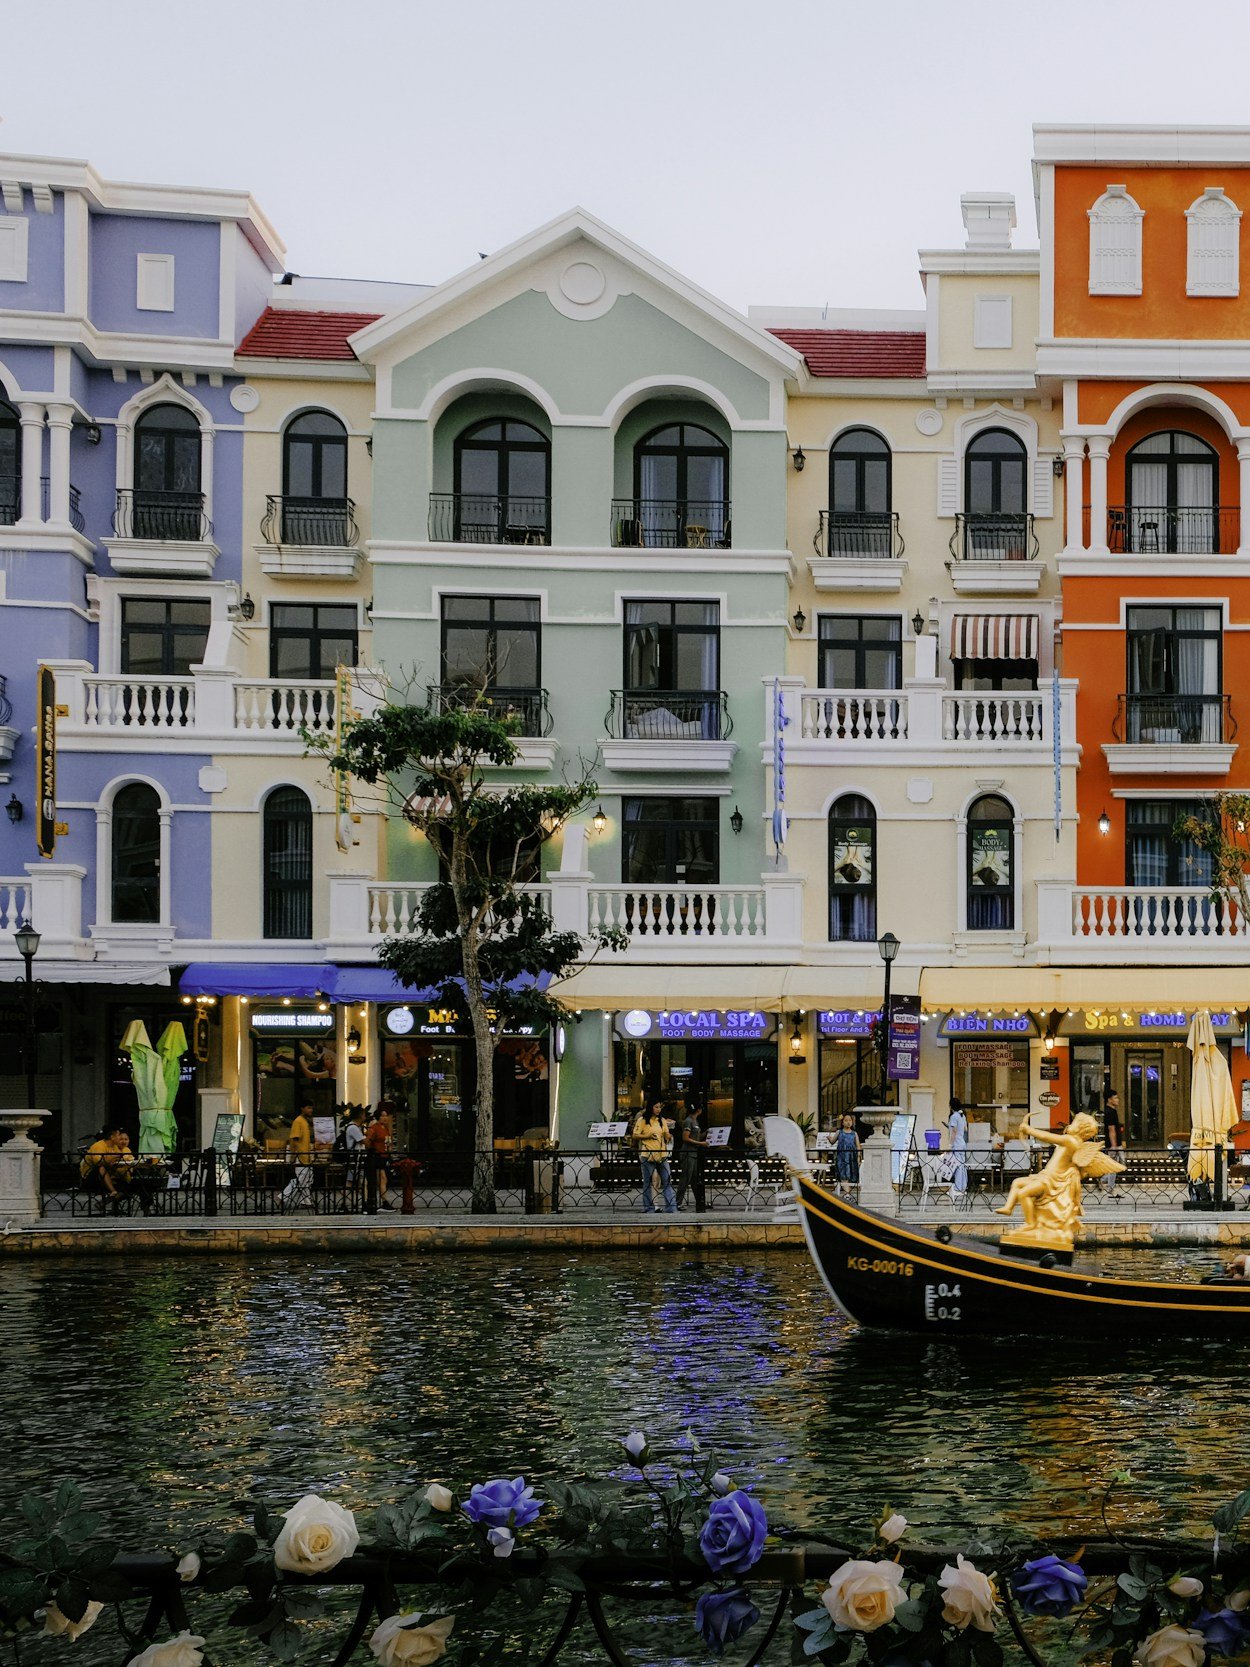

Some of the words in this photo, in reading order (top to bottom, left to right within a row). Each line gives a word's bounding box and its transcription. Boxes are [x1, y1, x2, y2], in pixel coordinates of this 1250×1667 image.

[252, 1015, 296, 1027] NOURISHING
[297, 1015, 333, 1027] SHAMPOO
[659, 1012, 720, 1028] LOCAL
[727, 1012, 766, 1028] SPA
[820, 1013, 850, 1023] FOOT
[852, 1012, 861, 1023] &
[1085, 1009, 1119, 1030] Spa
[1124, 1014, 1134, 1027] &
[1140, 1013, 1186, 1026] HOME
[421, 1026, 440, 1034] Foot
[662, 1029, 686, 1037] FOOT
[692, 1029, 715, 1037] BODY
[720, 1029, 761, 1037] MASSAGE
[847, 1256, 914, 1276] KG-00016
[938, 1283, 961, 1297] 0.4
[938, 1307, 961, 1320] 0.2
